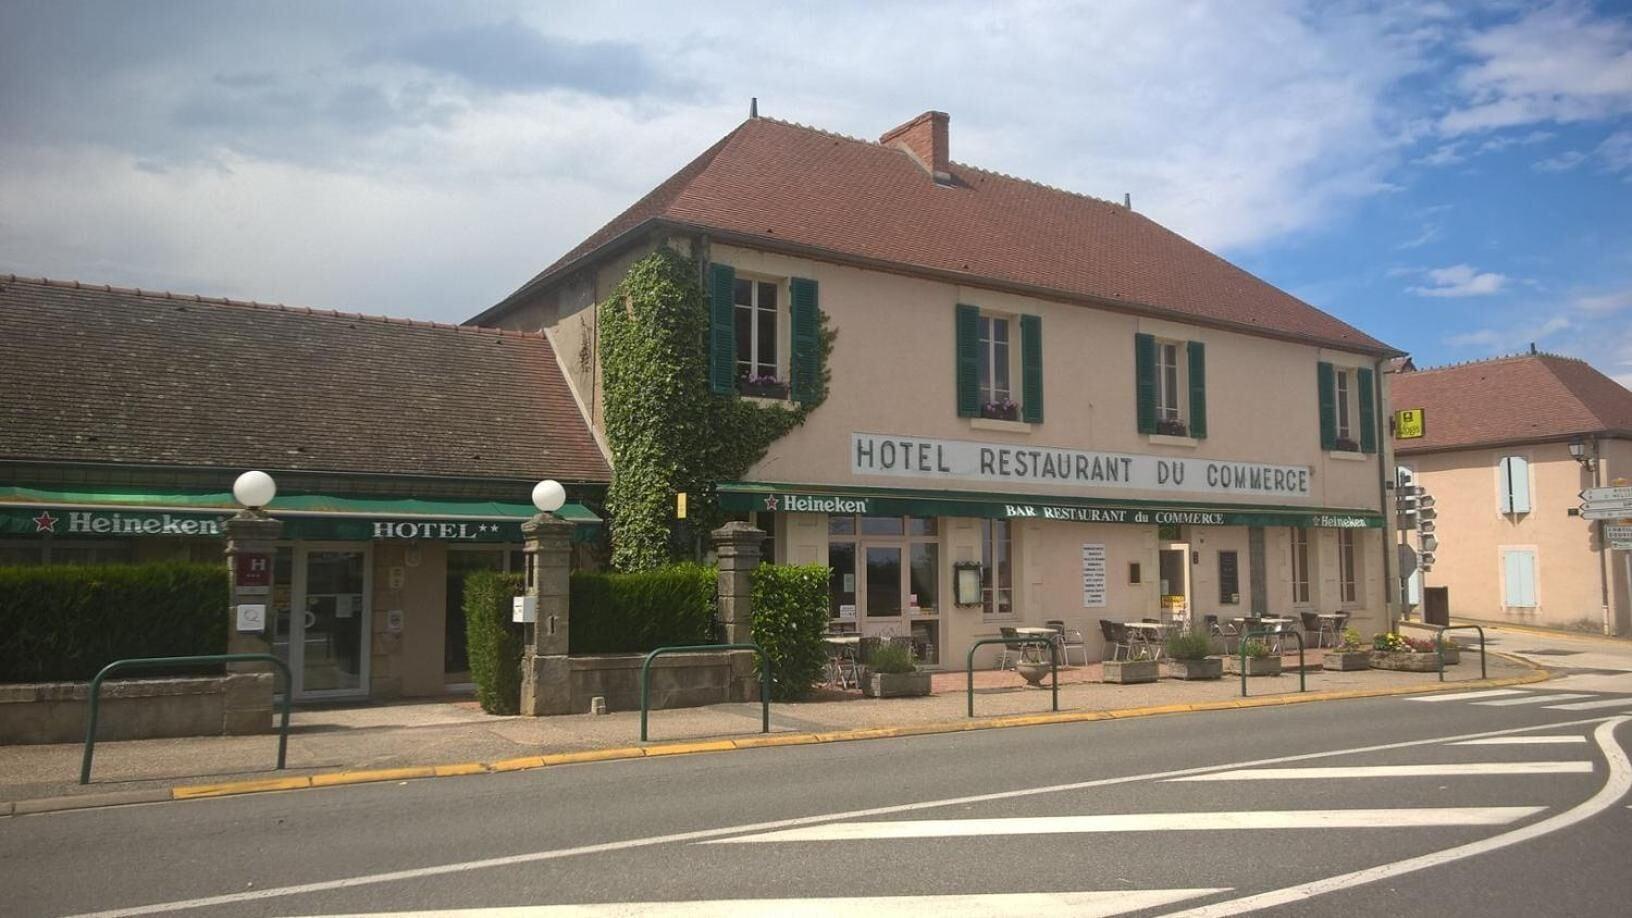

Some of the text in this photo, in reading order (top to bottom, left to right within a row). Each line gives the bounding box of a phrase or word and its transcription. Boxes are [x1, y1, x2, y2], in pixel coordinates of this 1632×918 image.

[857, 439, 1308, 492] HOTEL RESTAURANT DU COMMERCE
[784, 495, 866, 512] Heineken
[68, 511, 219, 535] Heineken
[1006, 504, 1224, 525] BAR RESTAURANT du COMMERCE
[1321, 515, 1367, 528] Heineken
[372, 521, 477, 539] HOTEL
[251, 558, 265, 571] H
